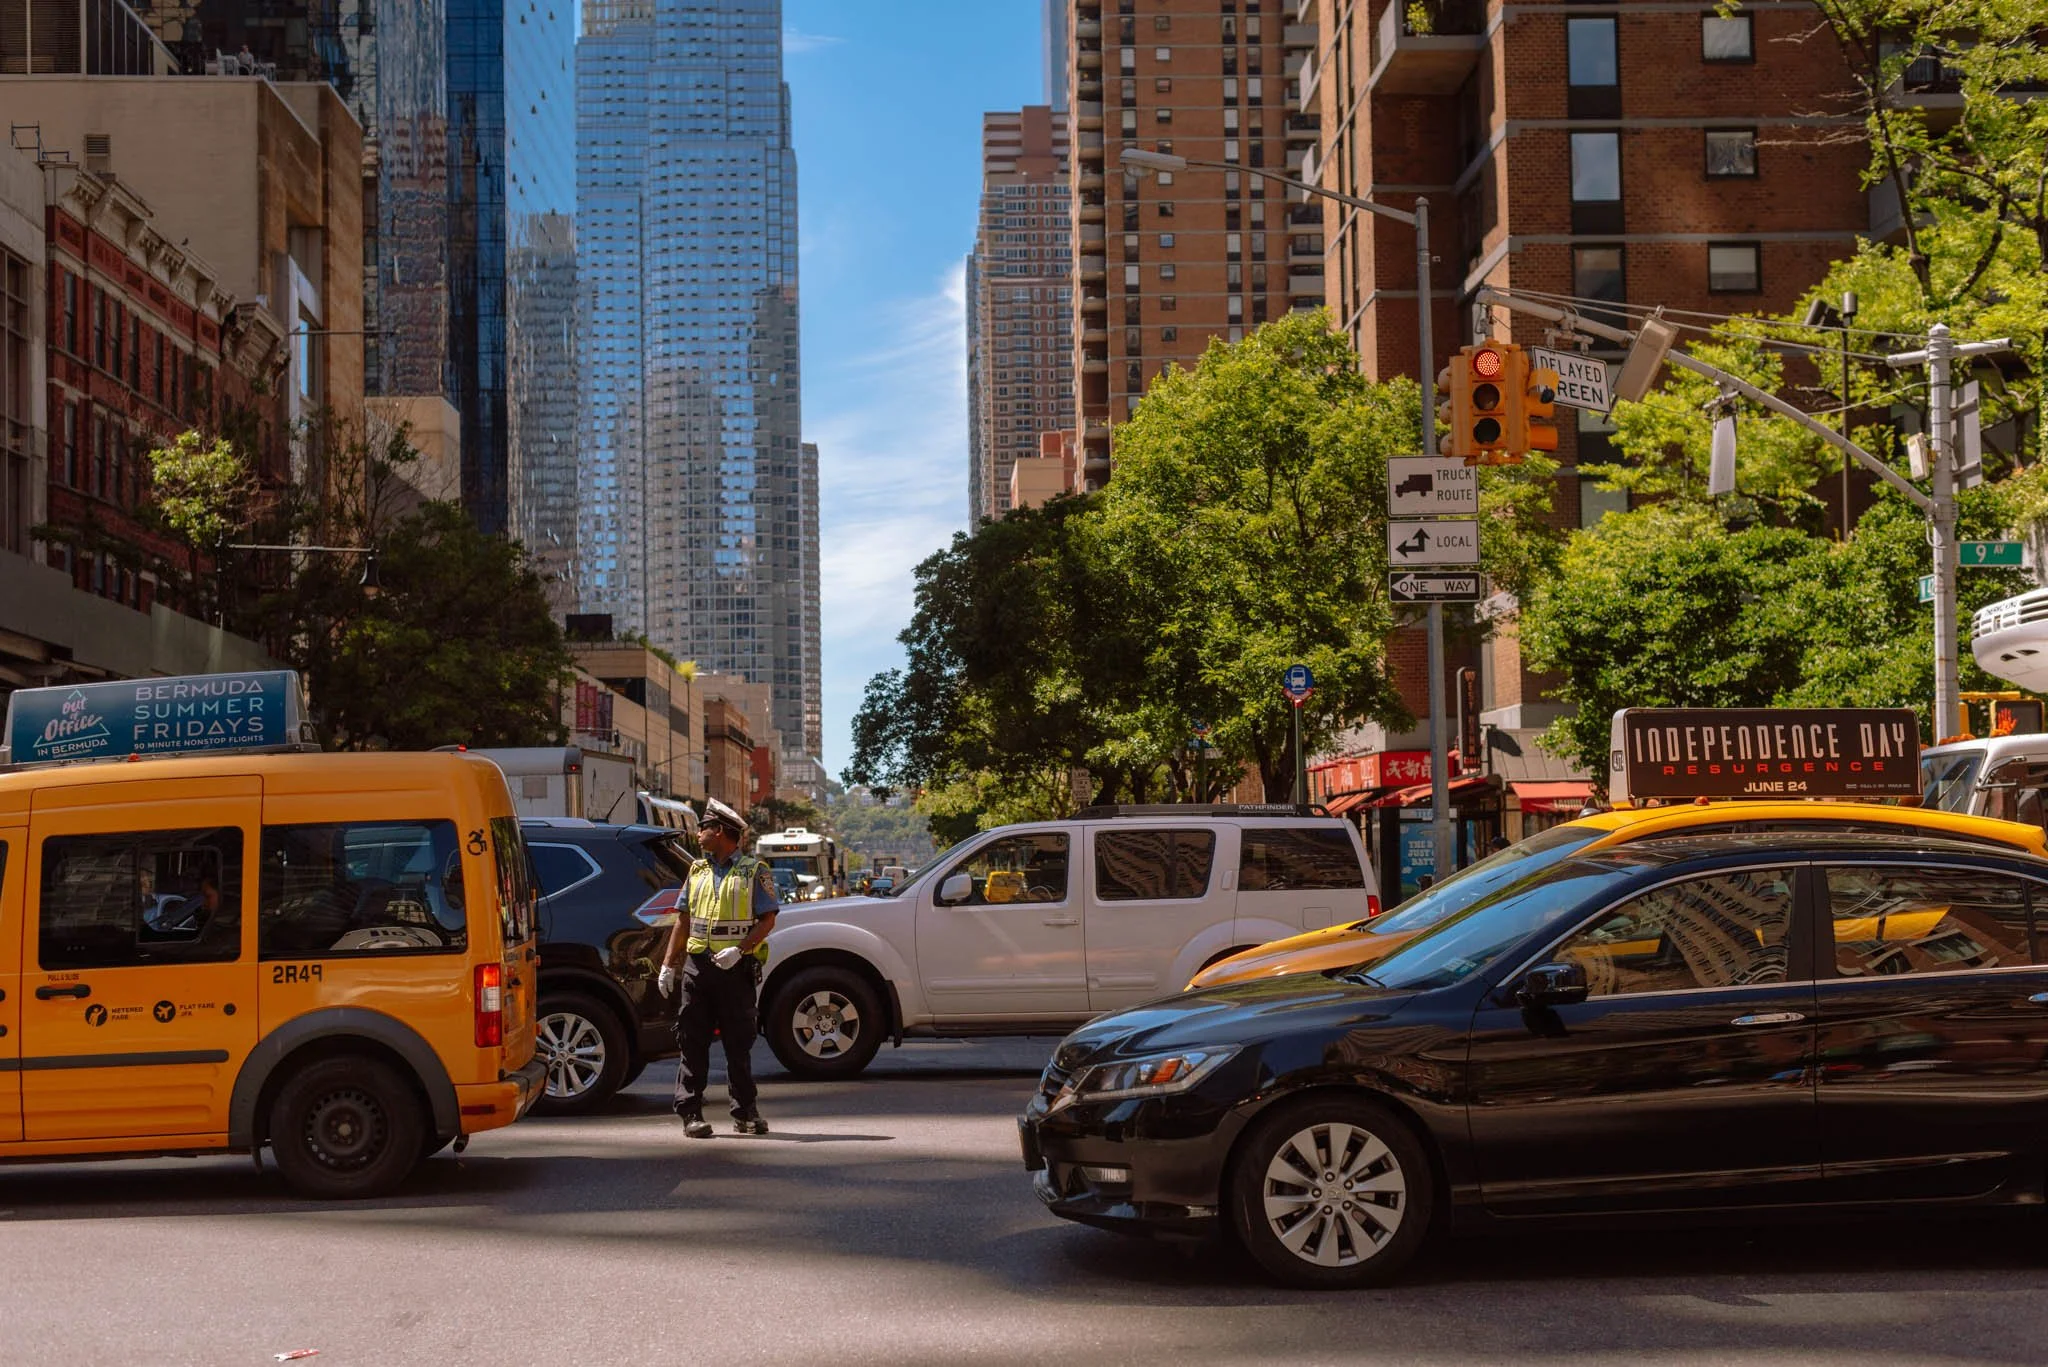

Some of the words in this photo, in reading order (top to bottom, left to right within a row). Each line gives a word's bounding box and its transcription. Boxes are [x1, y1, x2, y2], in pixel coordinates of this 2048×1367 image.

[1540, 356, 1602, 383] DELAYED
[1557, 380, 1604, 405] REEN
[1436, 469, 1472, 481] TRUCK
[1437, 489, 1473, 501] ROUTE
[1436, 535, 1473, 548] LOCAL
[1975, 544, 1987, 563] 9
[1993, 544, 2006, 555] AV
[1400, 581, 1429, 593] ONE
[1444, 580, 1472, 592] WAY
[135, 680, 264, 701] BERMUDA
[134, 697, 264, 720] SUMMER
[133, 716, 264, 740] FRIDAYS
[37, 747, 49, 757] IN
[51, 738, 108, 755] BERMUDA
[147, 740, 182, 749] MINUTE
[184, 737, 226, 747] NONSTOP
[228, 735, 264, 743] FLIGHTS
[1634, 723, 1841, 763] INDEPENDENCE
[1859, 723, 1906, 758] DAY
[1663, 761, 1886, 776] RESURGENCE
[1744, 782, 1785, 793] JUNE
[1787, 781, 1808, 792] 24
[273, 964, 323, 984] 2R49
